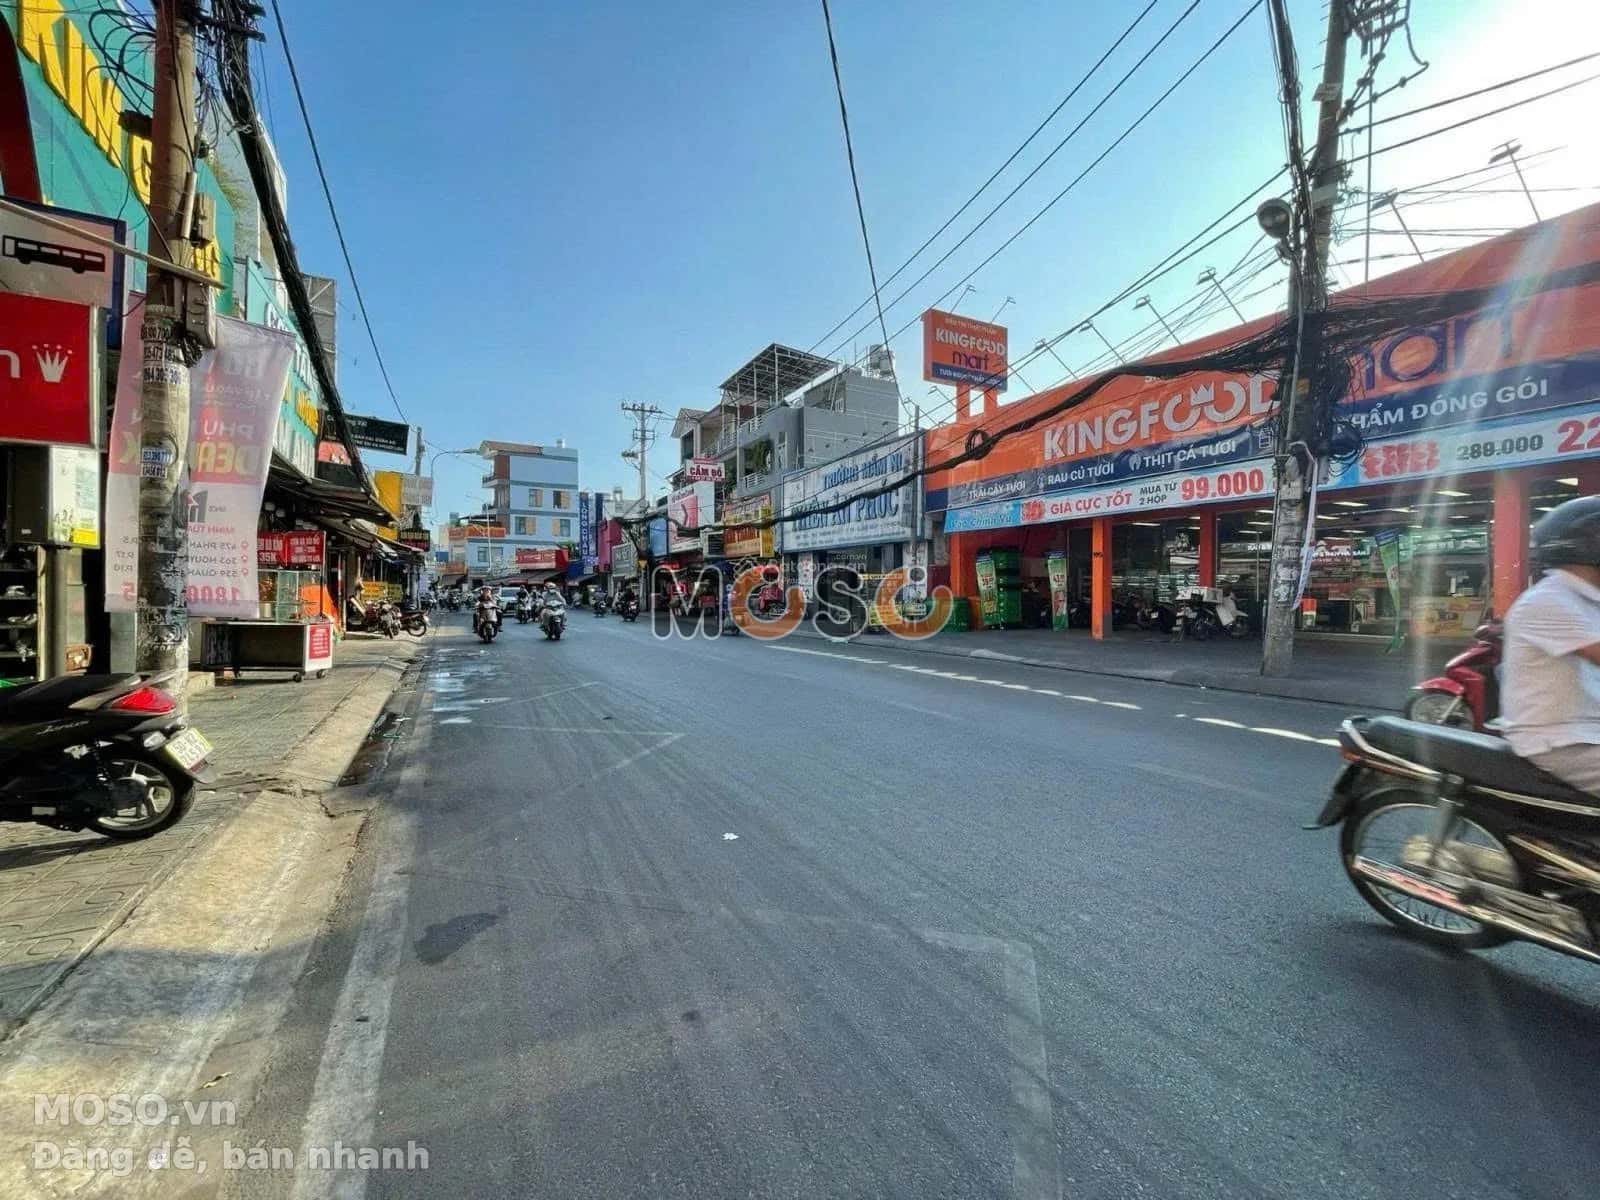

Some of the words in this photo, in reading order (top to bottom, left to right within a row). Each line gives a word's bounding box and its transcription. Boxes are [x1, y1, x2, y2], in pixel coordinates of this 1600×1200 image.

[935, 327, 1006, 356] KINGFOOD
[1410, 390, 1489, 421] ĐÓNG
[1494, 376, 1548, 404] GÓI
[1144, 450, 1174, 470] THỊT
[1176, 443, 1198, 462] CÁ
[1047, 474, 1068, 485] RAU
[1139, 484, 1162, 496] MUA
[1181, 468, 1264, 500] 99.000
[1106, 489, 1132, 508] TỐT
